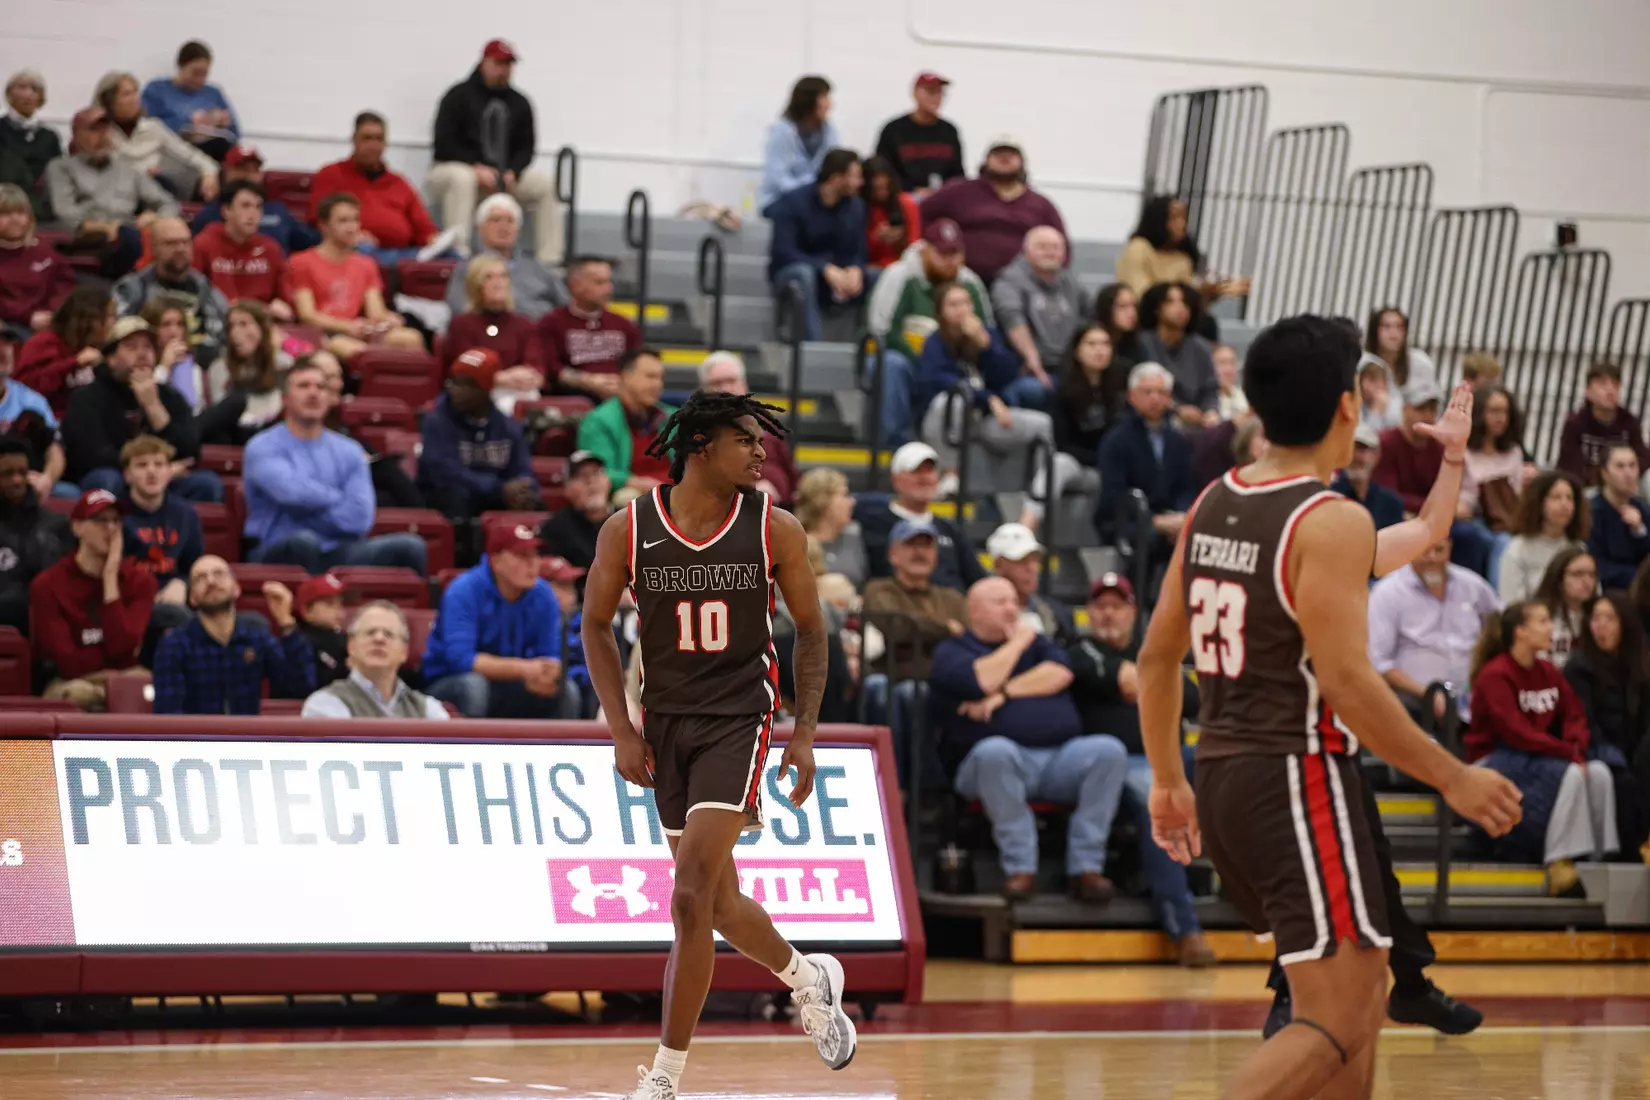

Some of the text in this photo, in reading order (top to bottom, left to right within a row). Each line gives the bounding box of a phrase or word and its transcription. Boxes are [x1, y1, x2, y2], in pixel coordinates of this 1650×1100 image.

[642, 563, 759, 592] BROWN
[1190, 533, 1260, 575] FERRARI
[674, 599, 731, 653] 10
[1188, 575, 1248, 680] 23
[63, 757, 876, 846] PROTECT THIS HSE.
[740, 867, 869, 915] ILL
